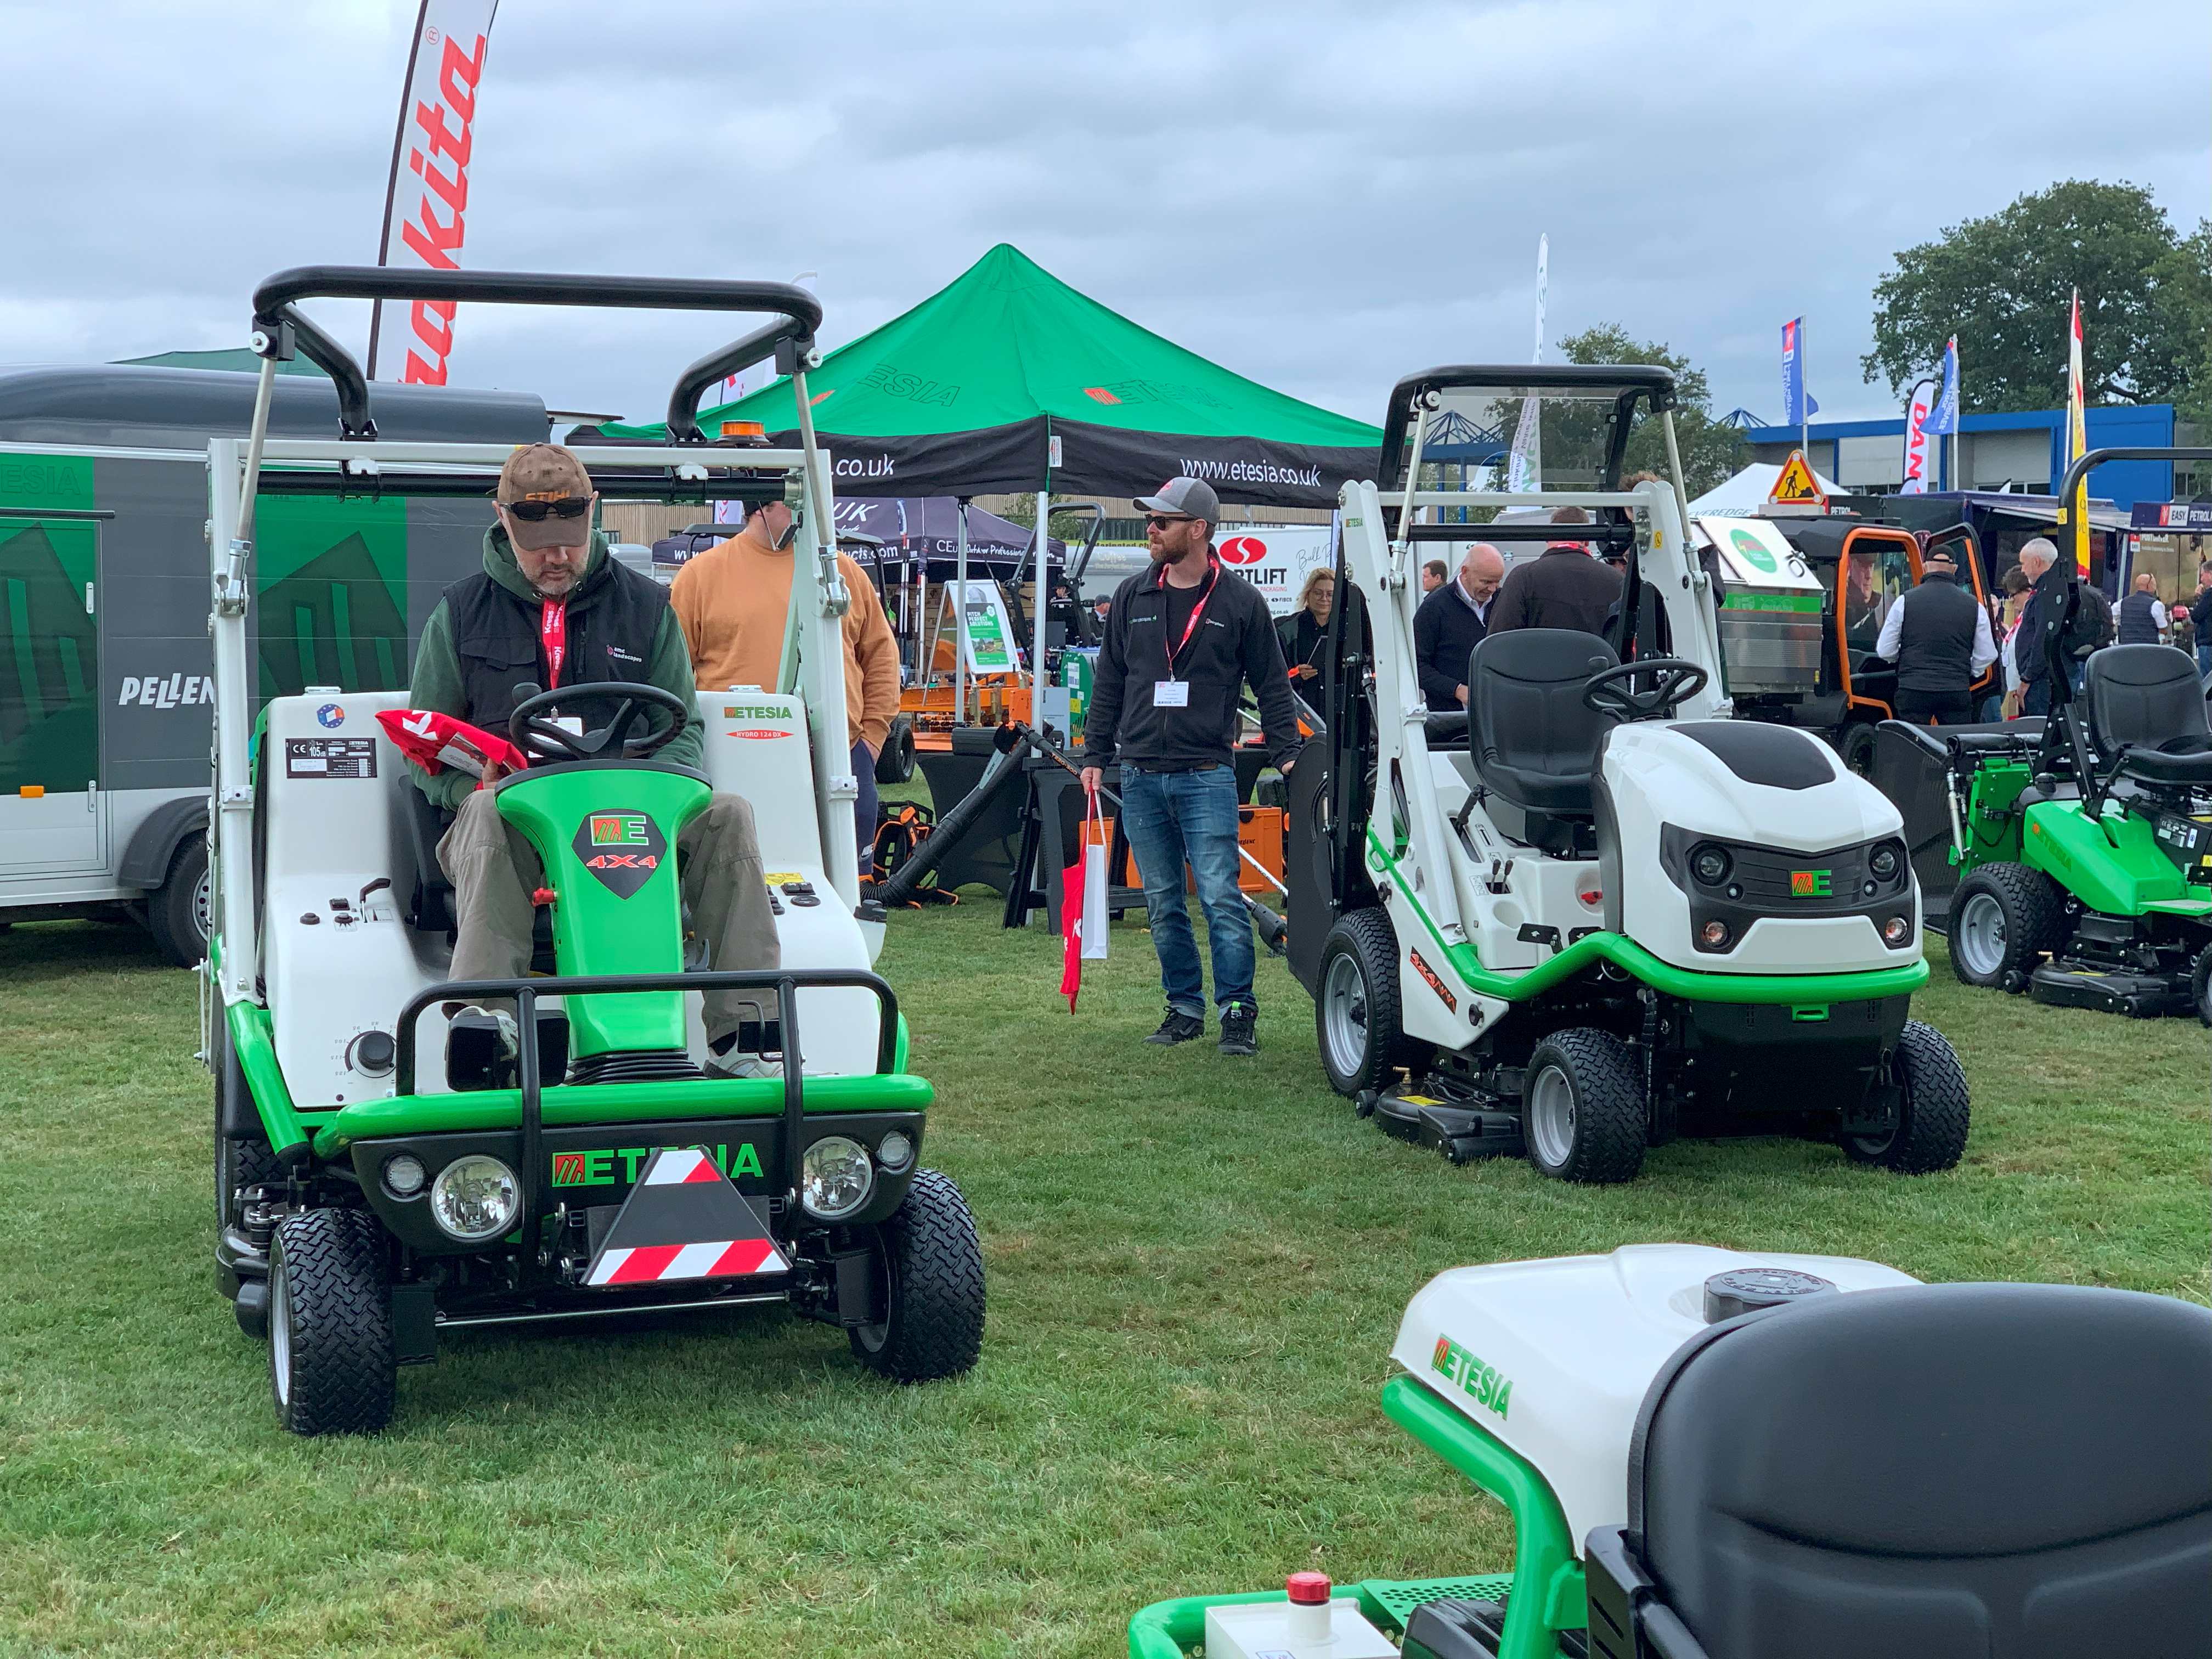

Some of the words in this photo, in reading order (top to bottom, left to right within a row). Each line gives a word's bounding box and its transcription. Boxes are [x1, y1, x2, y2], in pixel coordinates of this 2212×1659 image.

[1909, 402, 1927, 493] DAN
[1180, 459, 1321, 487] www.etesia.co.uk
[936, 539, 958, 552] CEu
[735, 707, 793, 719] ETESIA
[585, 1143, 764, 1186] ETIA
[1443, 1339, 1514, 1422] ETESIA
